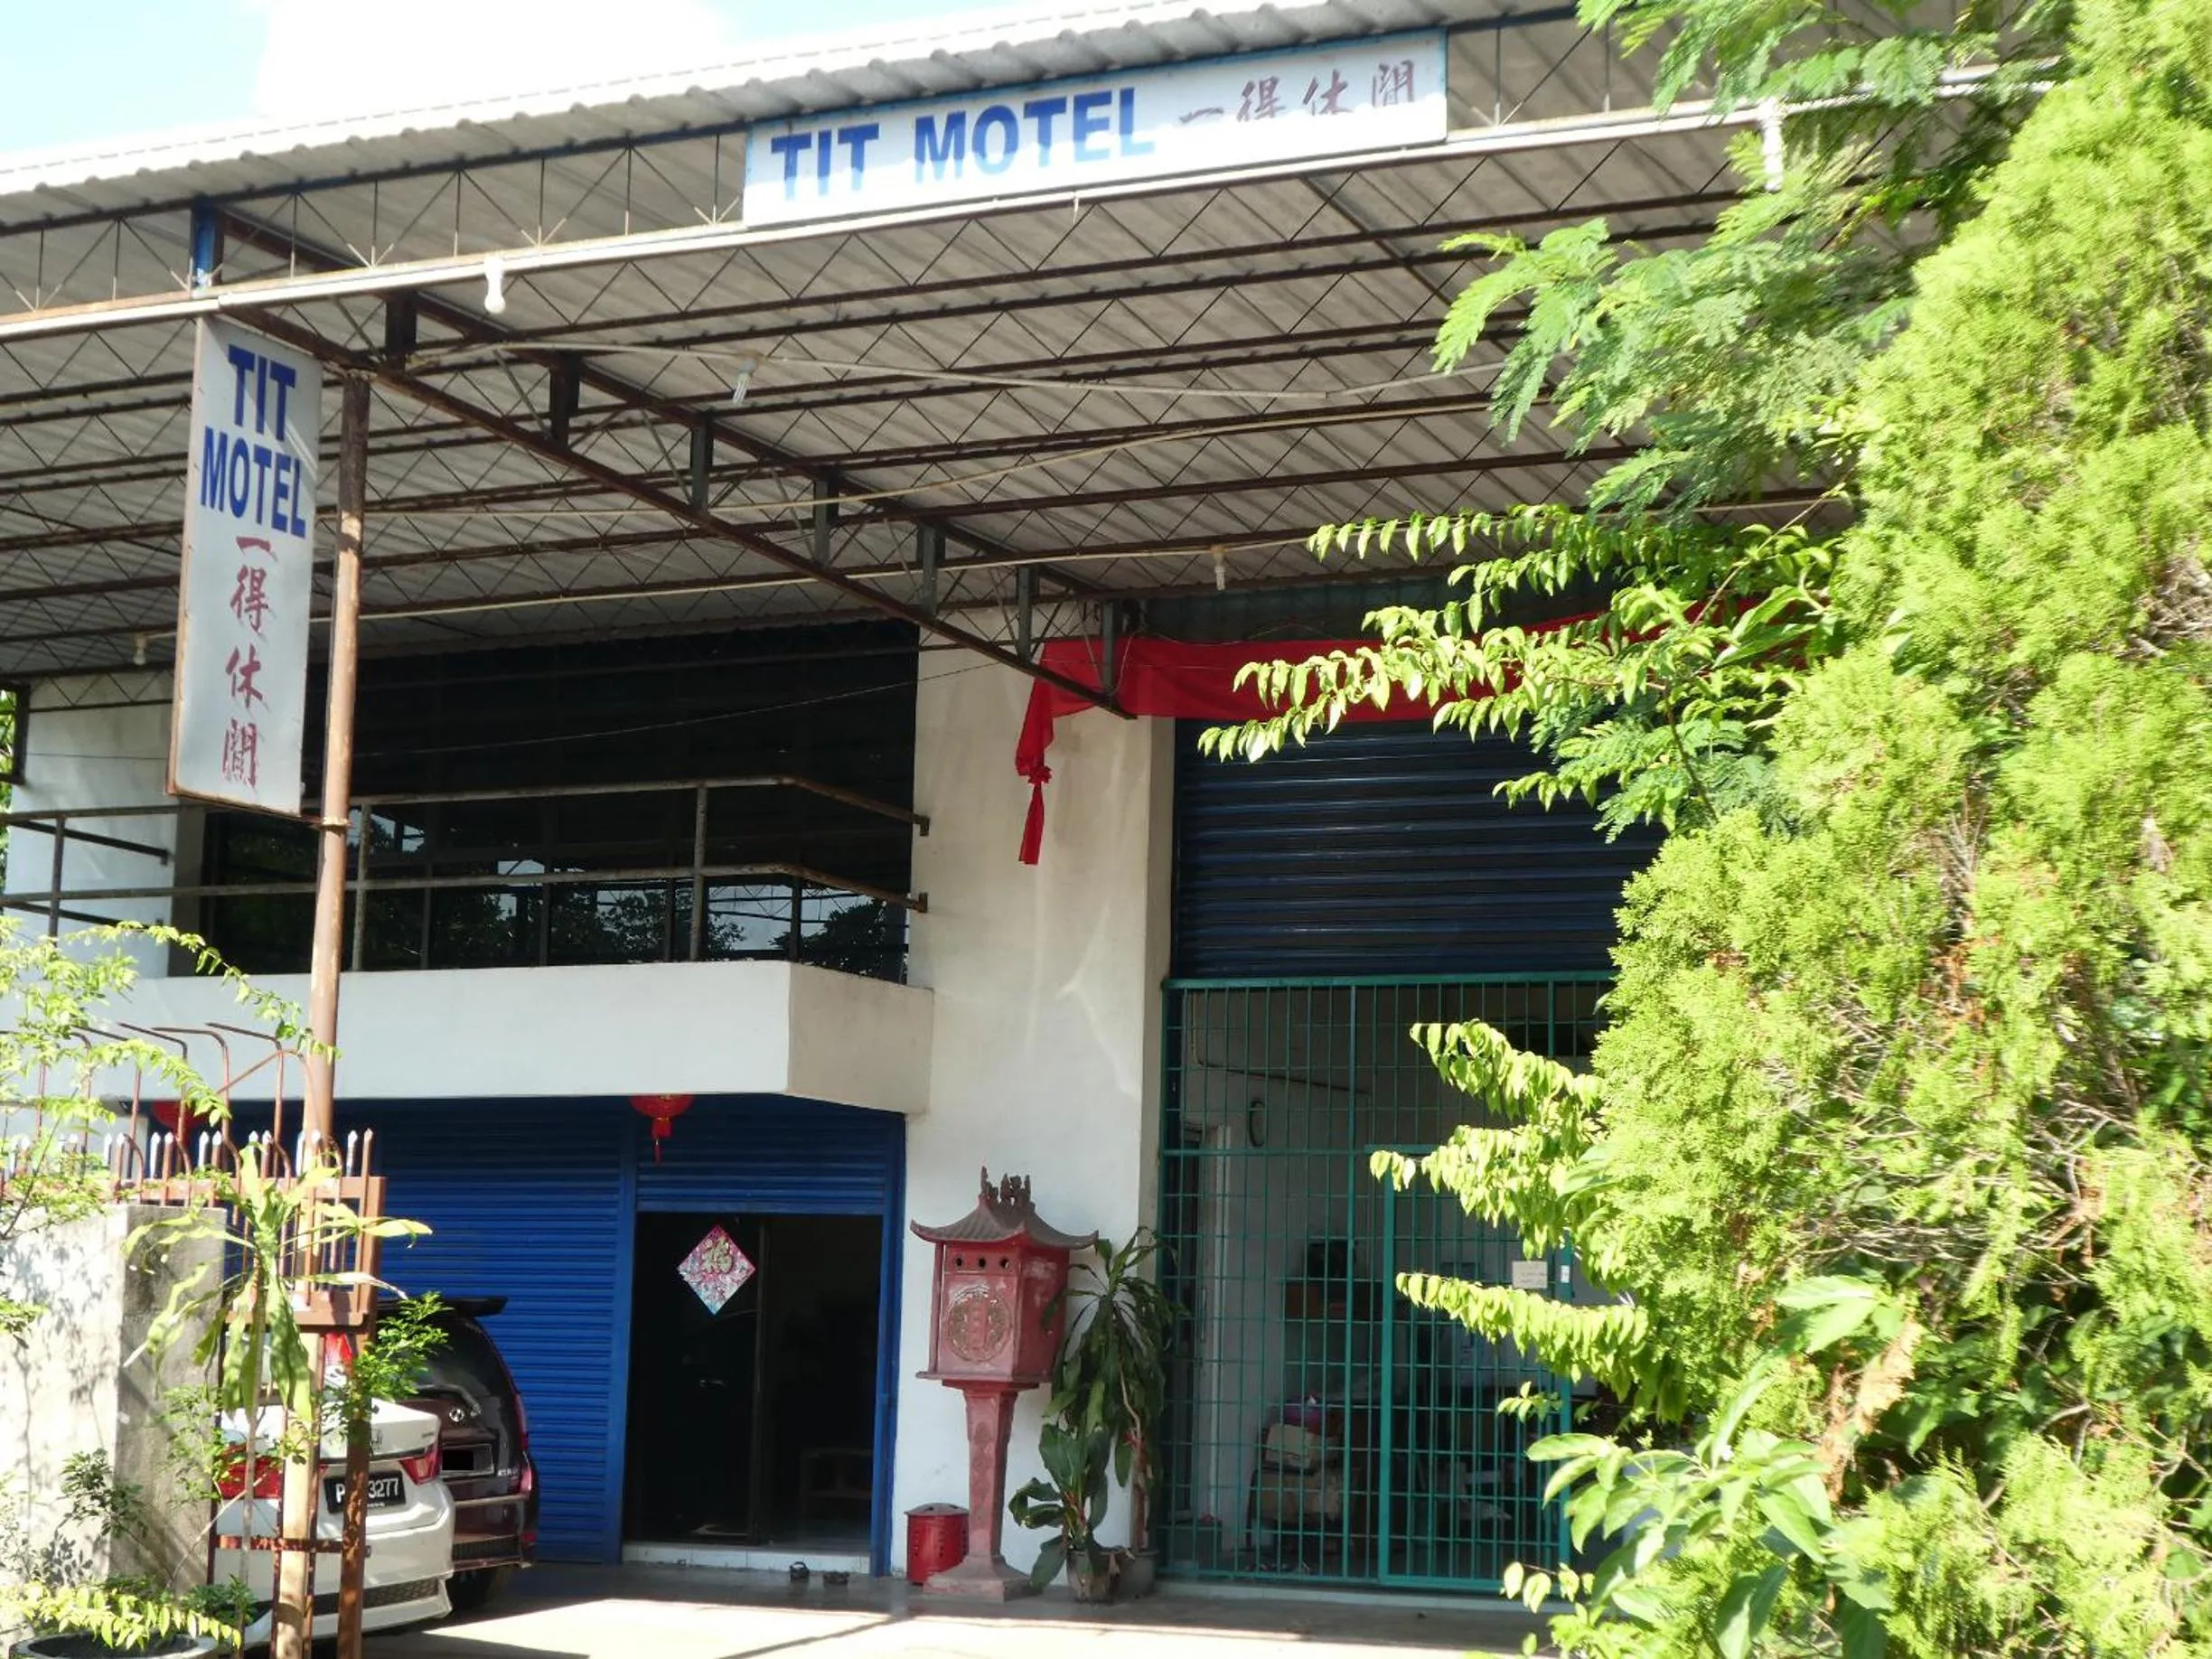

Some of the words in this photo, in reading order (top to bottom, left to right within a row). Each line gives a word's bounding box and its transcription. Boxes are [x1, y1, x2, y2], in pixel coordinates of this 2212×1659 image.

[771, 123, 879, 201] TIT
[914, 87, 1156, 183] MOTEL
[228, 343, 296, 442] TIT
[201, 425, 306, 539] MOTEL
[368, 1477, 399, 1498] 3277
